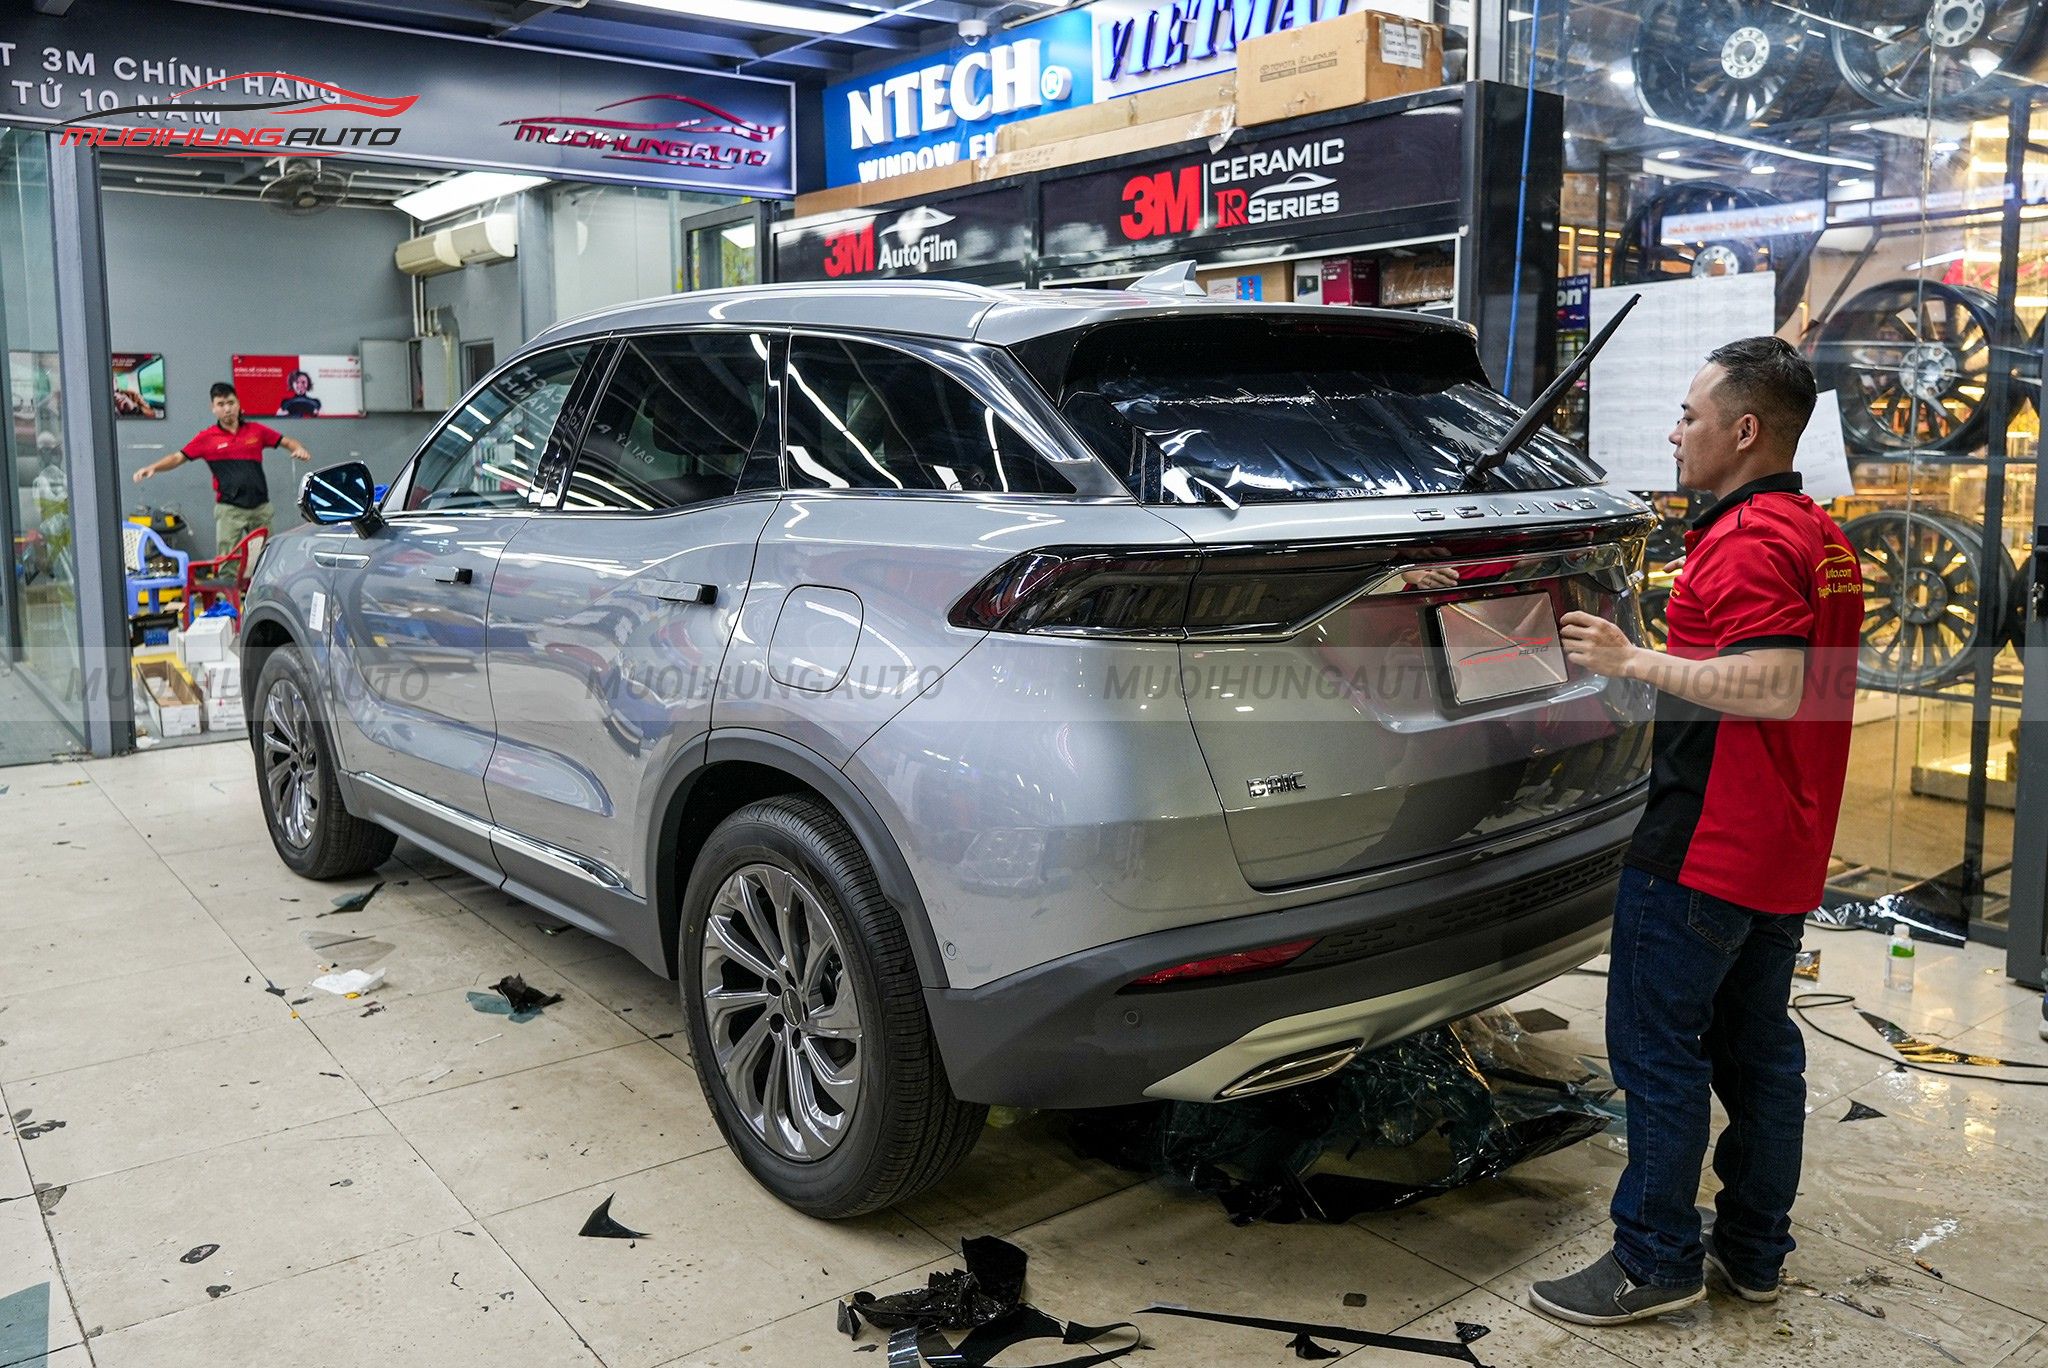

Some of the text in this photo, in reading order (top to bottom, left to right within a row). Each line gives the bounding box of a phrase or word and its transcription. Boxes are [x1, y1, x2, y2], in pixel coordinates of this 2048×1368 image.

[1098, 0, 1350, 81] VIETNA
[43, 47, 95, 76] 3M
[113, 57, 226, 91] CHÍNH
[80, 89, 119, 112] 10
[858, 141, 960, 184] WINDOW
[969, 132, 995, 161] FI
[1210, 138, 1345, 185] CERAMIC
[1120, 165, 1200, 241] 3M
[824, 223, 957, 278] 3M AutoFilm
[1412, 497, 1599, 522] BEIJING
[1247, 771, 1307, 798] BAIC
